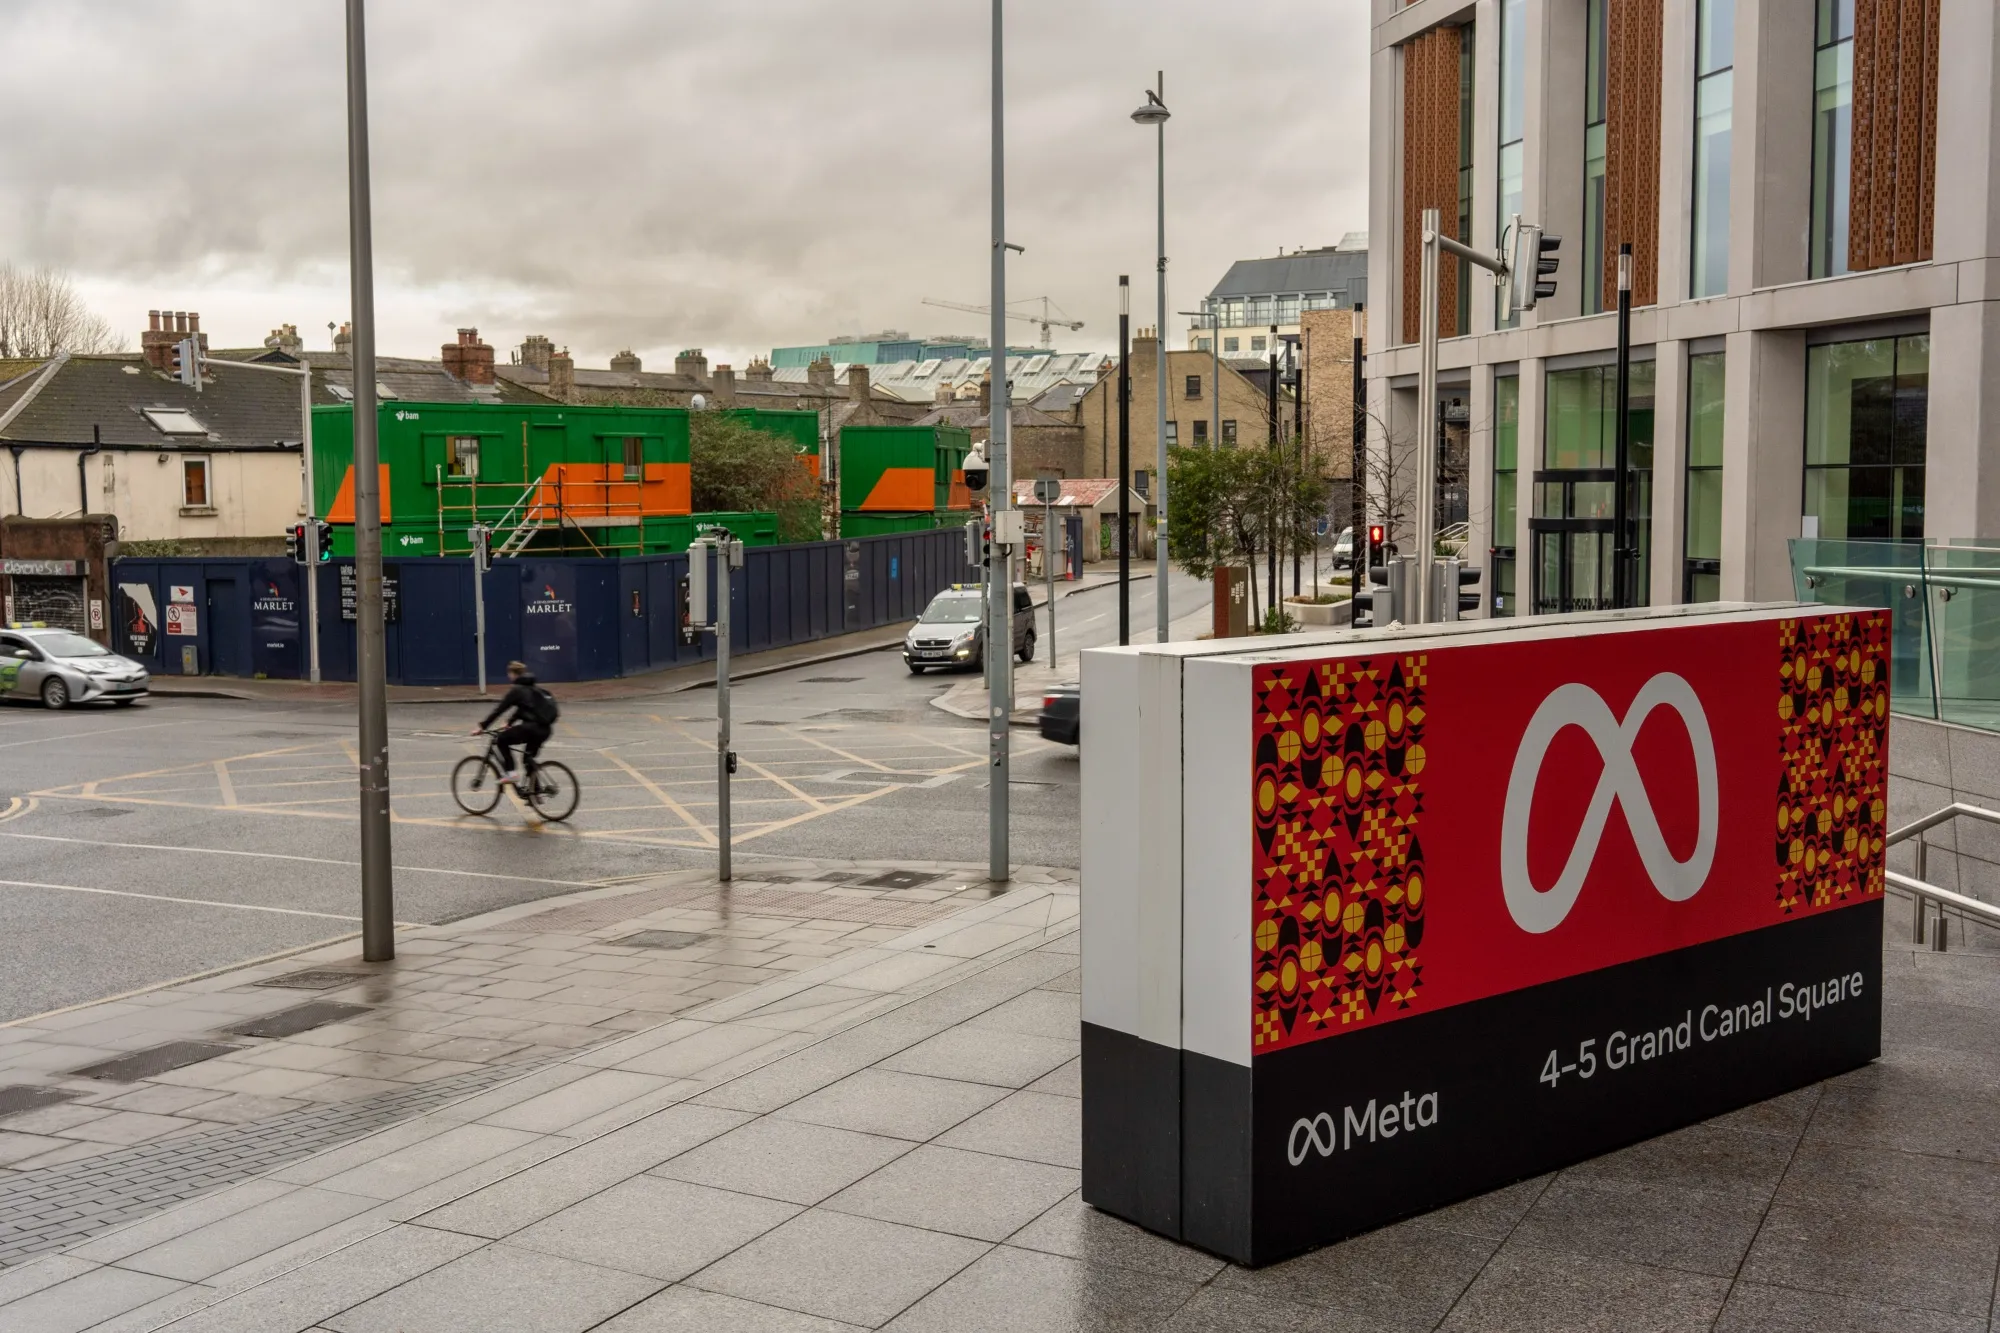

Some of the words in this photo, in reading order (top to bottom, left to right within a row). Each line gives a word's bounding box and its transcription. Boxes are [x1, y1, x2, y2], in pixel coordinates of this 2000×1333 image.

[405, 410, 419, 420] bam
[410, 535, 424, 544] bam
[254, 601, 294, 611] MARLET
[526, 603, 572, 614] MARLET
[1606, 1010, 1692, 1070] Grand
[1699, 987, 1771, 1041] Canal
[1778, 971, 1863, 1021] Square
[1344, 1090, 1438, 1151] Meta
